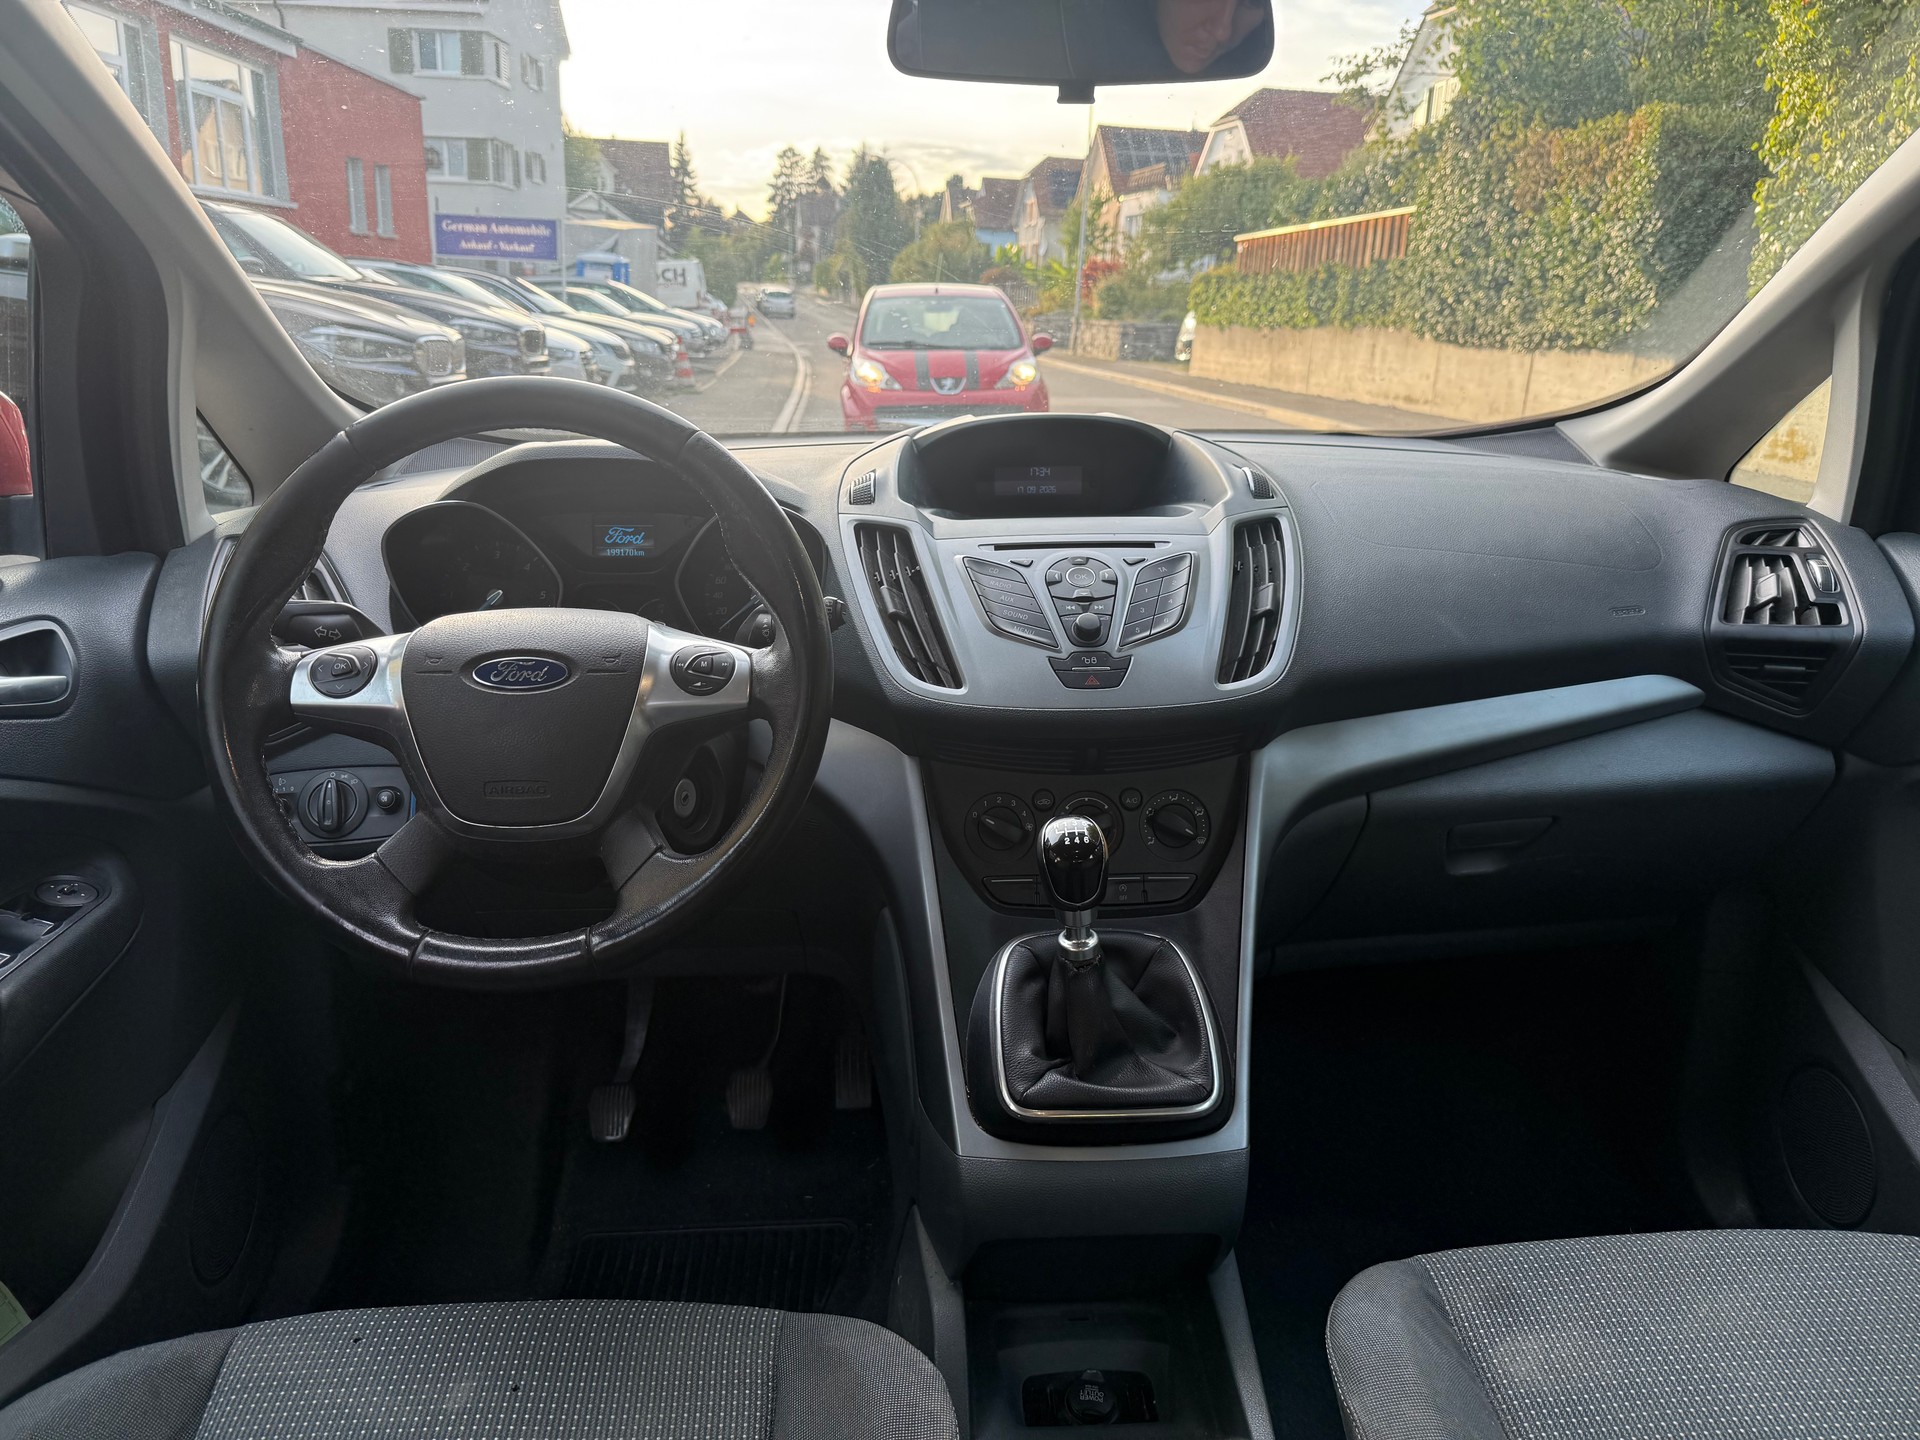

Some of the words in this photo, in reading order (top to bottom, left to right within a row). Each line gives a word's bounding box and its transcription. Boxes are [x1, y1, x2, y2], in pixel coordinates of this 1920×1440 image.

[441, 218, 488, 234] German
[489, 222, 552, 238] Automobile
[656, 267, 687, 287] CH
[1030, 466, 1051, 477] 17:34
[604, 526, 646, 545] Ford
[988, 567, 1000, 575] CD
[1074, 572, 1088, 580] OK
[990, 579, 1012, 590] RADIO
[1000, 594, 1015, 604] AUX
[1002, 609, 1029, 621] SOUND
[1013, 625, 1037, 636] MENU
[334, 661, 347, 670] OK
[490, 659, 549, 683] Ford
[488, 784, 547, 795] AIRBAG
[996, 796, 1002, 804] 2
[1011, 799, 1016, 807] 3
[1064, 837, 1071, 845] 2
[1074, 836, 1080, 844] 4
[1083, 836, 1090, 844] 6
